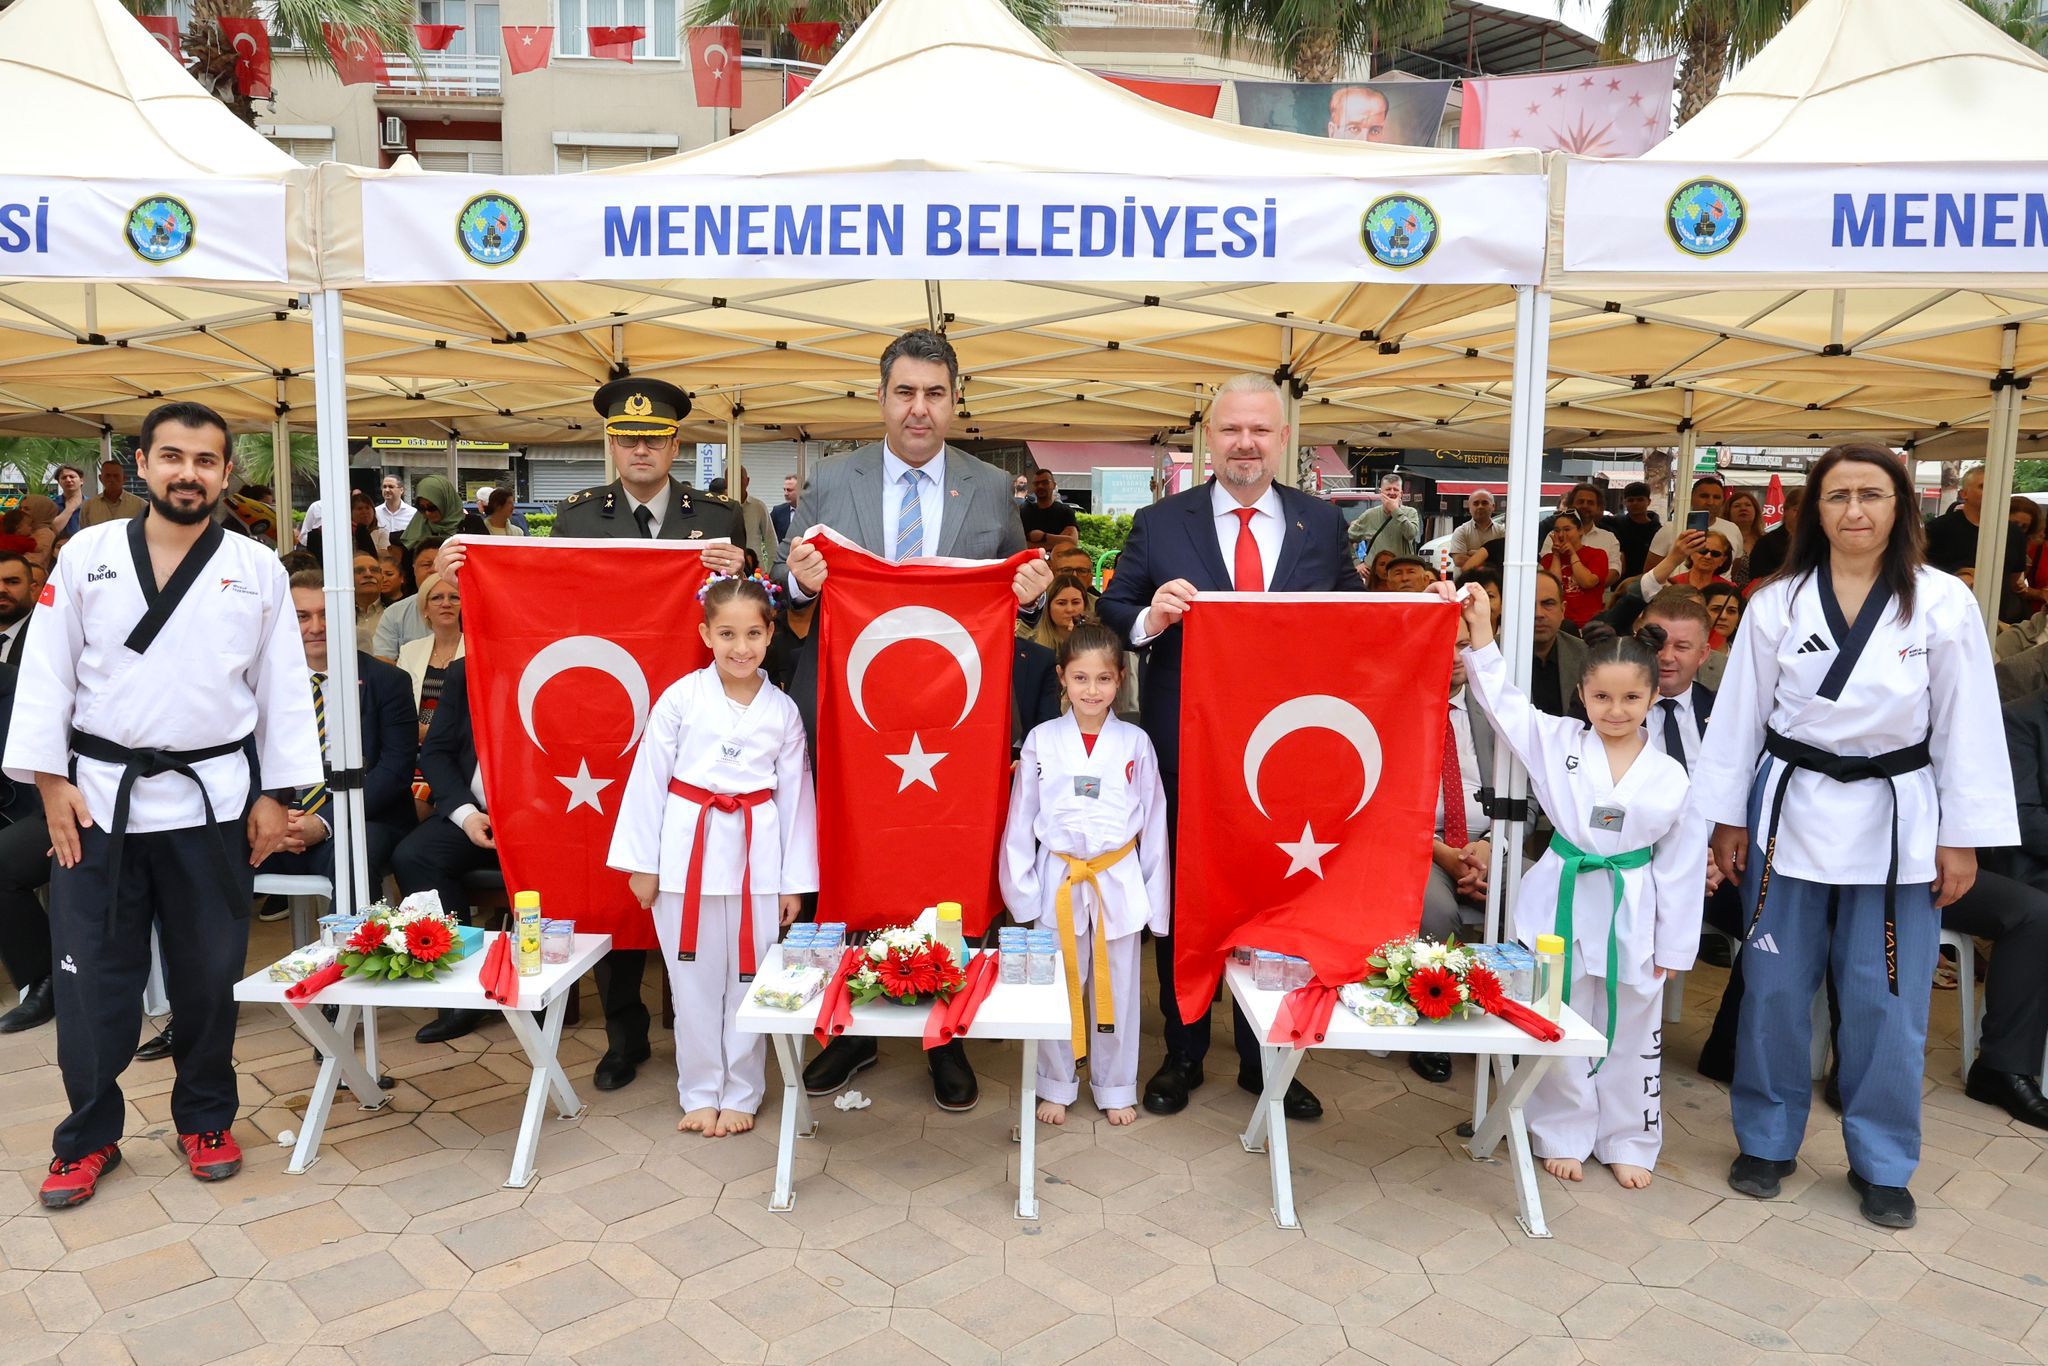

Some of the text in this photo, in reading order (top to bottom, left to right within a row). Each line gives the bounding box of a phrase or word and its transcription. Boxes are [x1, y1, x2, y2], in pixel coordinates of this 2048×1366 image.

[603, 196, 1278, 259] MENEMEN BELEDİYESİ
[88, 569, 117, 582] Daedo
